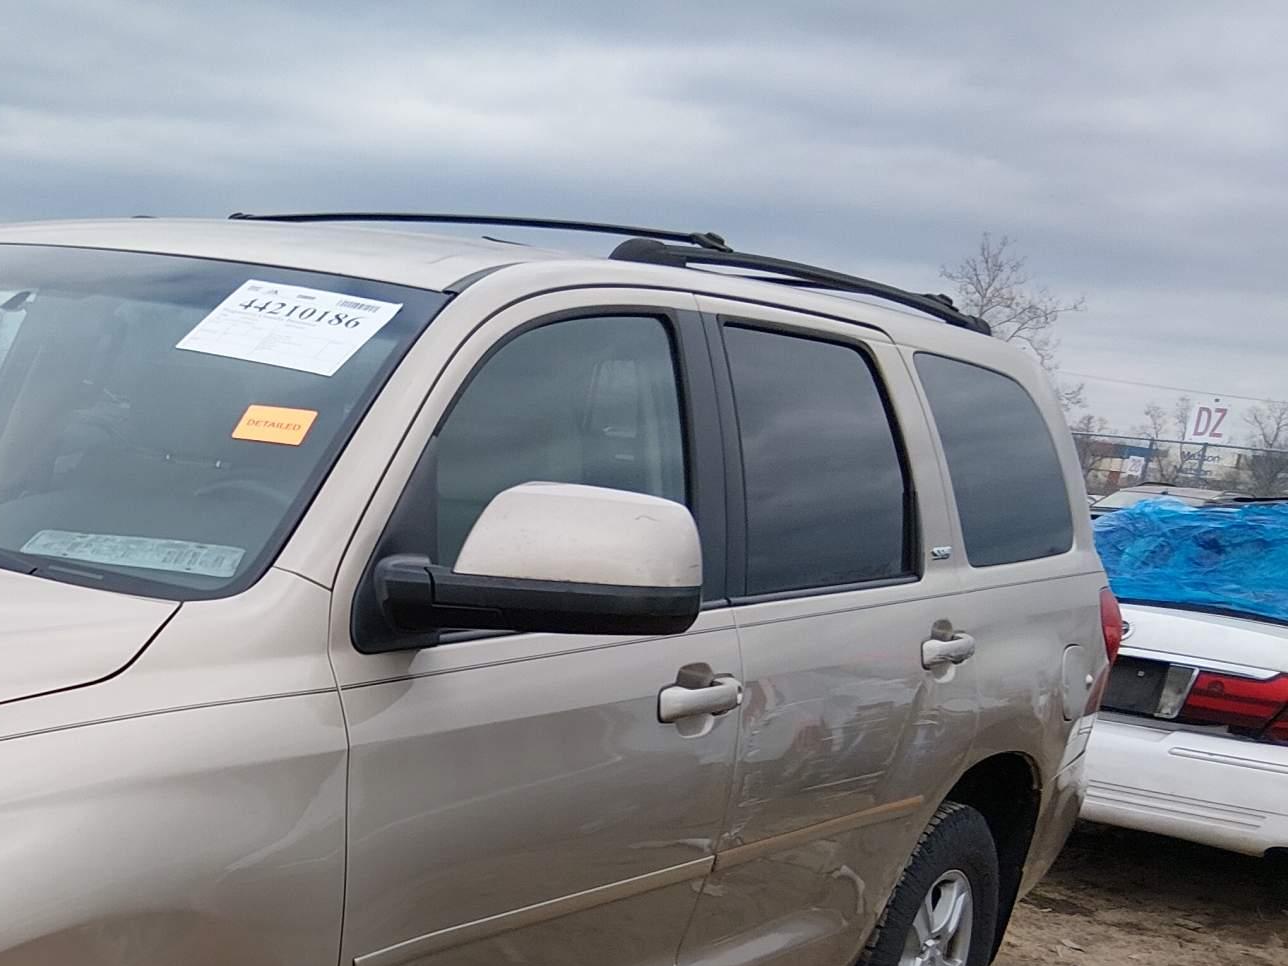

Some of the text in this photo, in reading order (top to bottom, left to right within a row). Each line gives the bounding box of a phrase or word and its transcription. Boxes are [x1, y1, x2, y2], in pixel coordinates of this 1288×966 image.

[239, 297, 364, 329] 44210186
[246, 418, 302, 431] DETAILED
[1192, 406, 1228, 438] DZ
